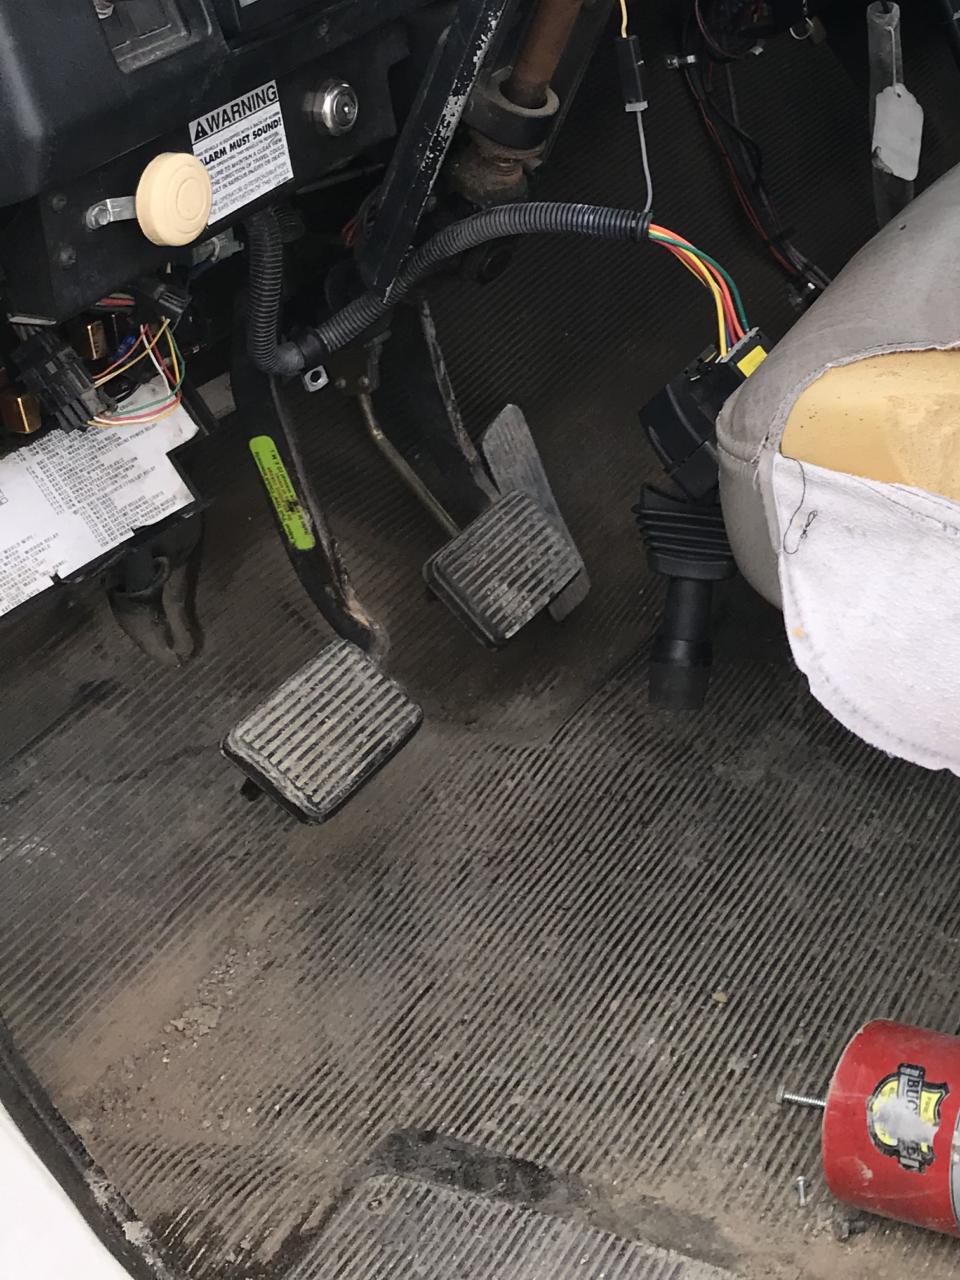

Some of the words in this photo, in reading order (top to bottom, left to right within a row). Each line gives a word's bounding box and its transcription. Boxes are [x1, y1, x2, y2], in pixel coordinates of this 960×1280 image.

[205, 84, 279, 132] WARNING
[227, 133, 252, 152] MUST
[251, 117, 282, 139] SOUND!
[256, 142, 271, 155] CLEAR
[220, 165, 246, 182] DIRECTION
